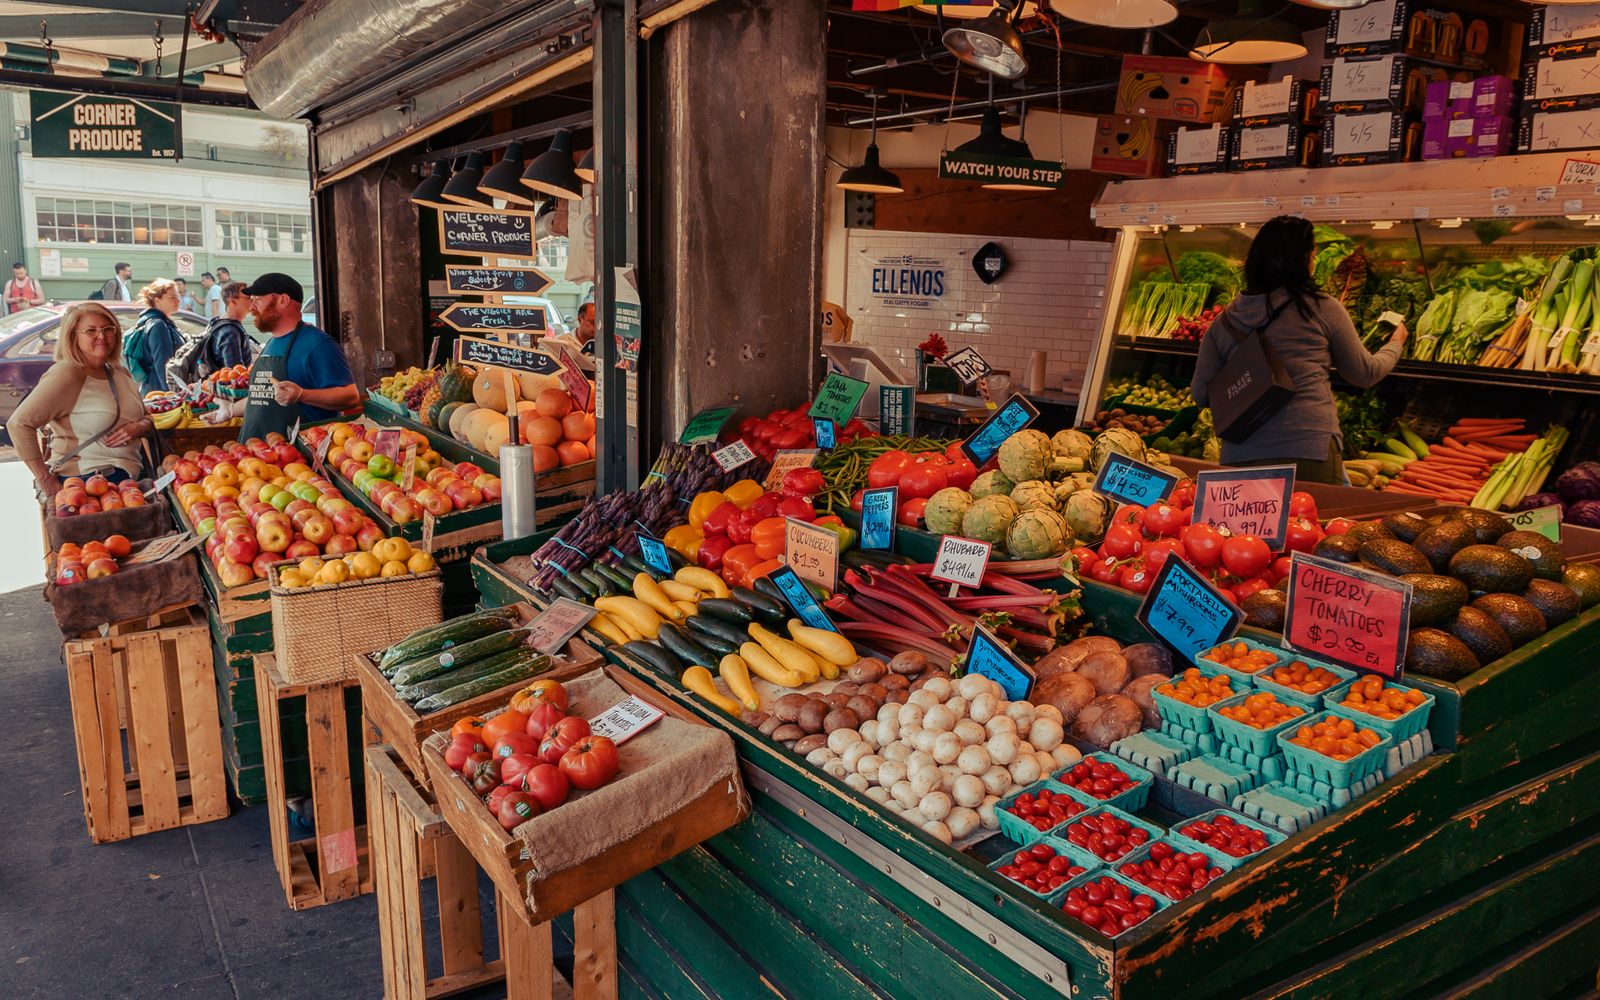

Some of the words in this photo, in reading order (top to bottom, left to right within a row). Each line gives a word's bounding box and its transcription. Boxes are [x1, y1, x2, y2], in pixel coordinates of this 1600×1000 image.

[74, 104, 136, 126] CORNER
[69, 129, 142, 151] PRODUCE
[945, 161, 994, 177] WATCH
[997, 165, 1030, 181] YOUR
[1032, 169, 1062, 183] STEP
[1569, 162, 1597, 177] CORN
[444, 212, 507, 225] WELCOME
[491, 230, 530, 244] PRODUCE
[872, 268, 945, 297] ELLENOS
[460, 308, 479, 316] THE
[1210, 484, 1243, 502] VINE
[1218, 499, 1278, 518] TOMATOES
[790, 526, 833, 555] CUCUMBERS
[943, 540, 986, 557] RHUBARB
[1173, 566, 1229, 618] PORTABELLO
[1301, 568, 1375, 607] CHERRY
[1165, 579, 1218, 622] MUSHROOMS
[1304, 596, 1385, 638] TOMATOES
